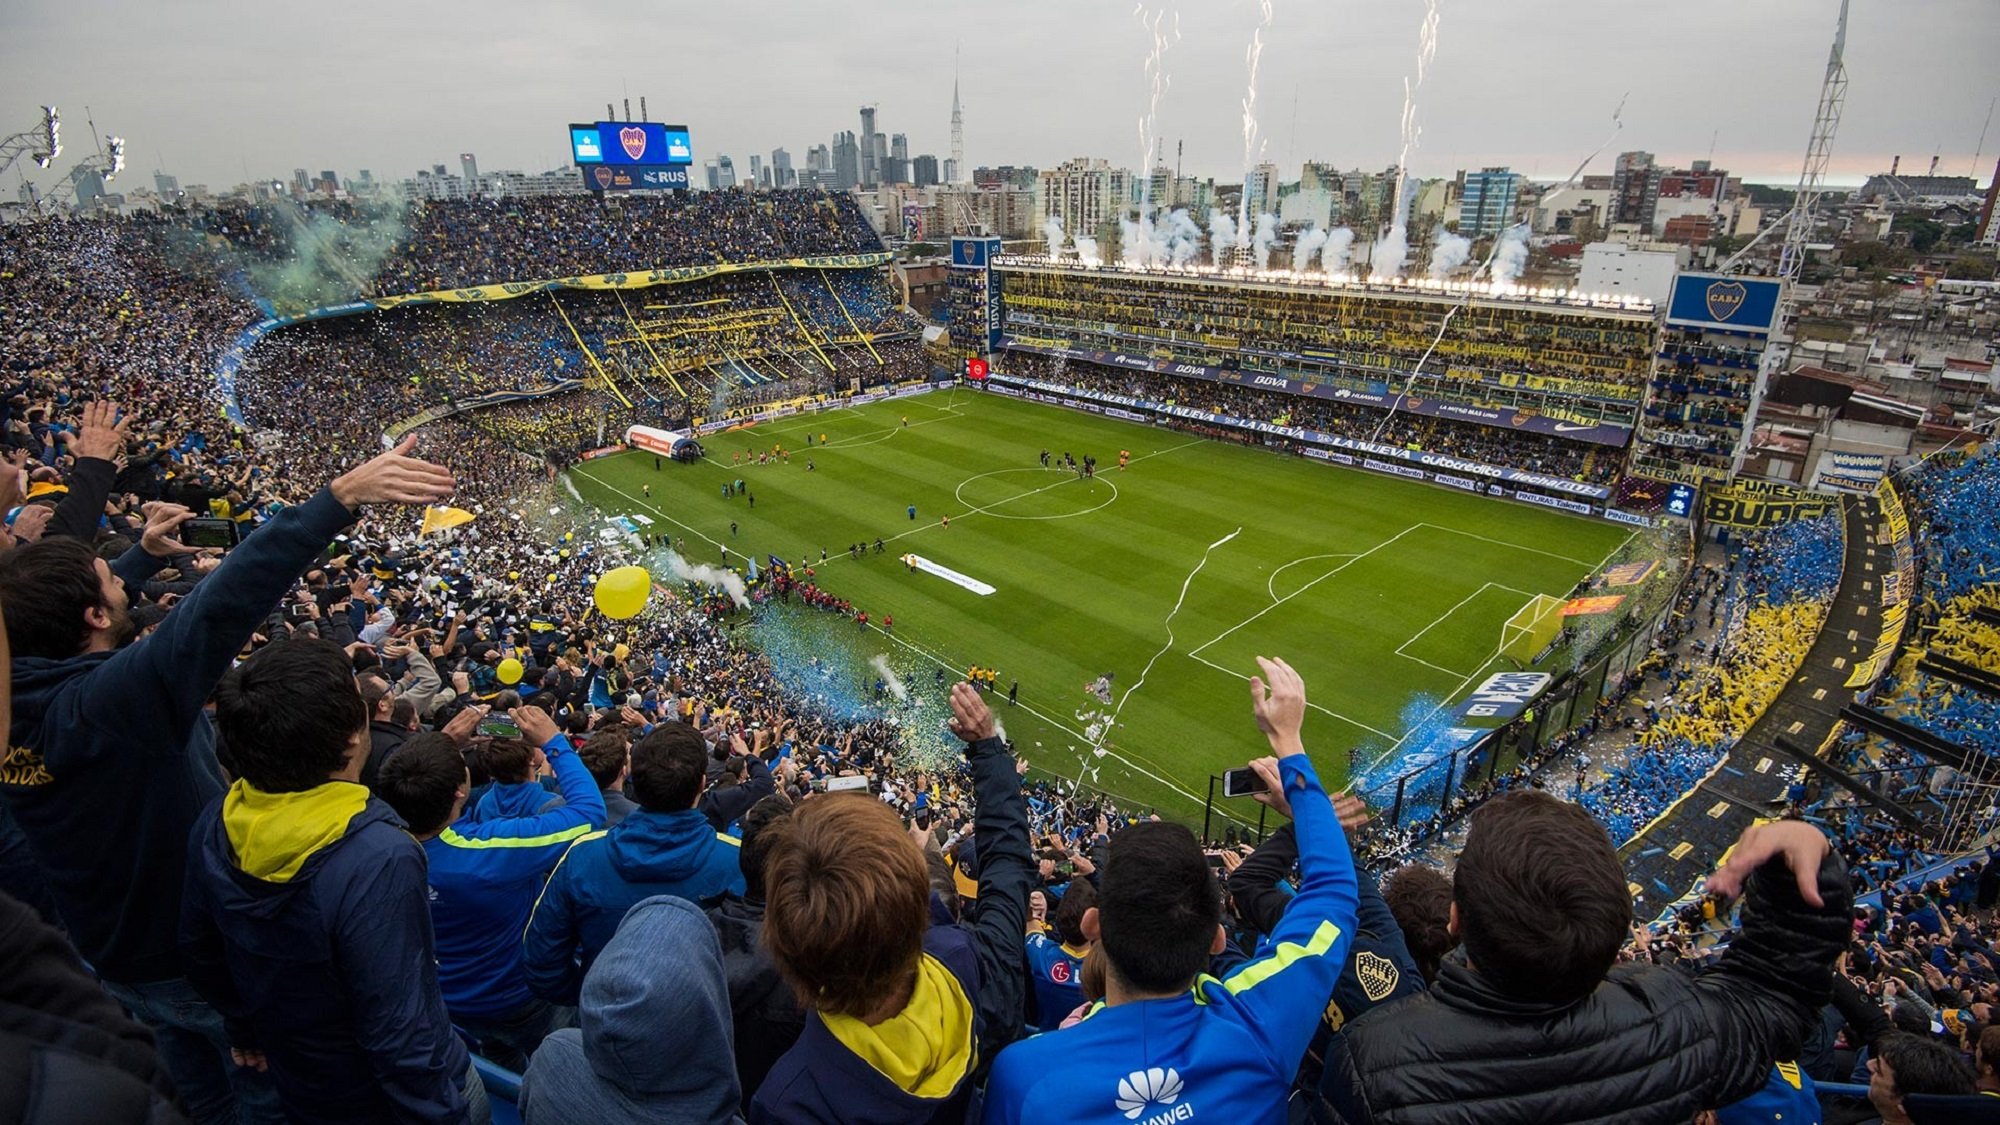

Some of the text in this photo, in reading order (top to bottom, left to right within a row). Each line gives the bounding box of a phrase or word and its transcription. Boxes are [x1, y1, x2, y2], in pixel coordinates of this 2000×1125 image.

[658, 171, 686, 183] RUS
[1710, 295, 1740, 303] CABJ
[991, 296, 1000, 329] BBVA
[1175, 364, 1205, 376] BBVA
[1253, 375, 1288, 388] BBVA
[1085, 391, 1100, 400] LA
[1100, 393, 1136, 406] NUEVA
[1351, 393, 1384, 401] HUAWEI
[1156, 404, 1215, 422] LA NUEVA
[1482, 411, 1499, 419] UNO
[1238, 419, 1305, 440] LA NUEVA
[1332, 437, 1411, 459] LA NUEVA
[1365, 461, 1422, 478] PINTURAS Talento
[1421, 454, 1502, 478] autocrédito
[1632, 464, 1699, 486] PATERNAL
[1438, 475, 1470, 488] PINTURAS
[1732, 478, 1799, 499] FUNES
[1518, 492, 1588, 512] PINTURAS Talento
[1361, 965, 1392, 984] CABJ
[1133, 1102, 1194, 1125] AWEI
